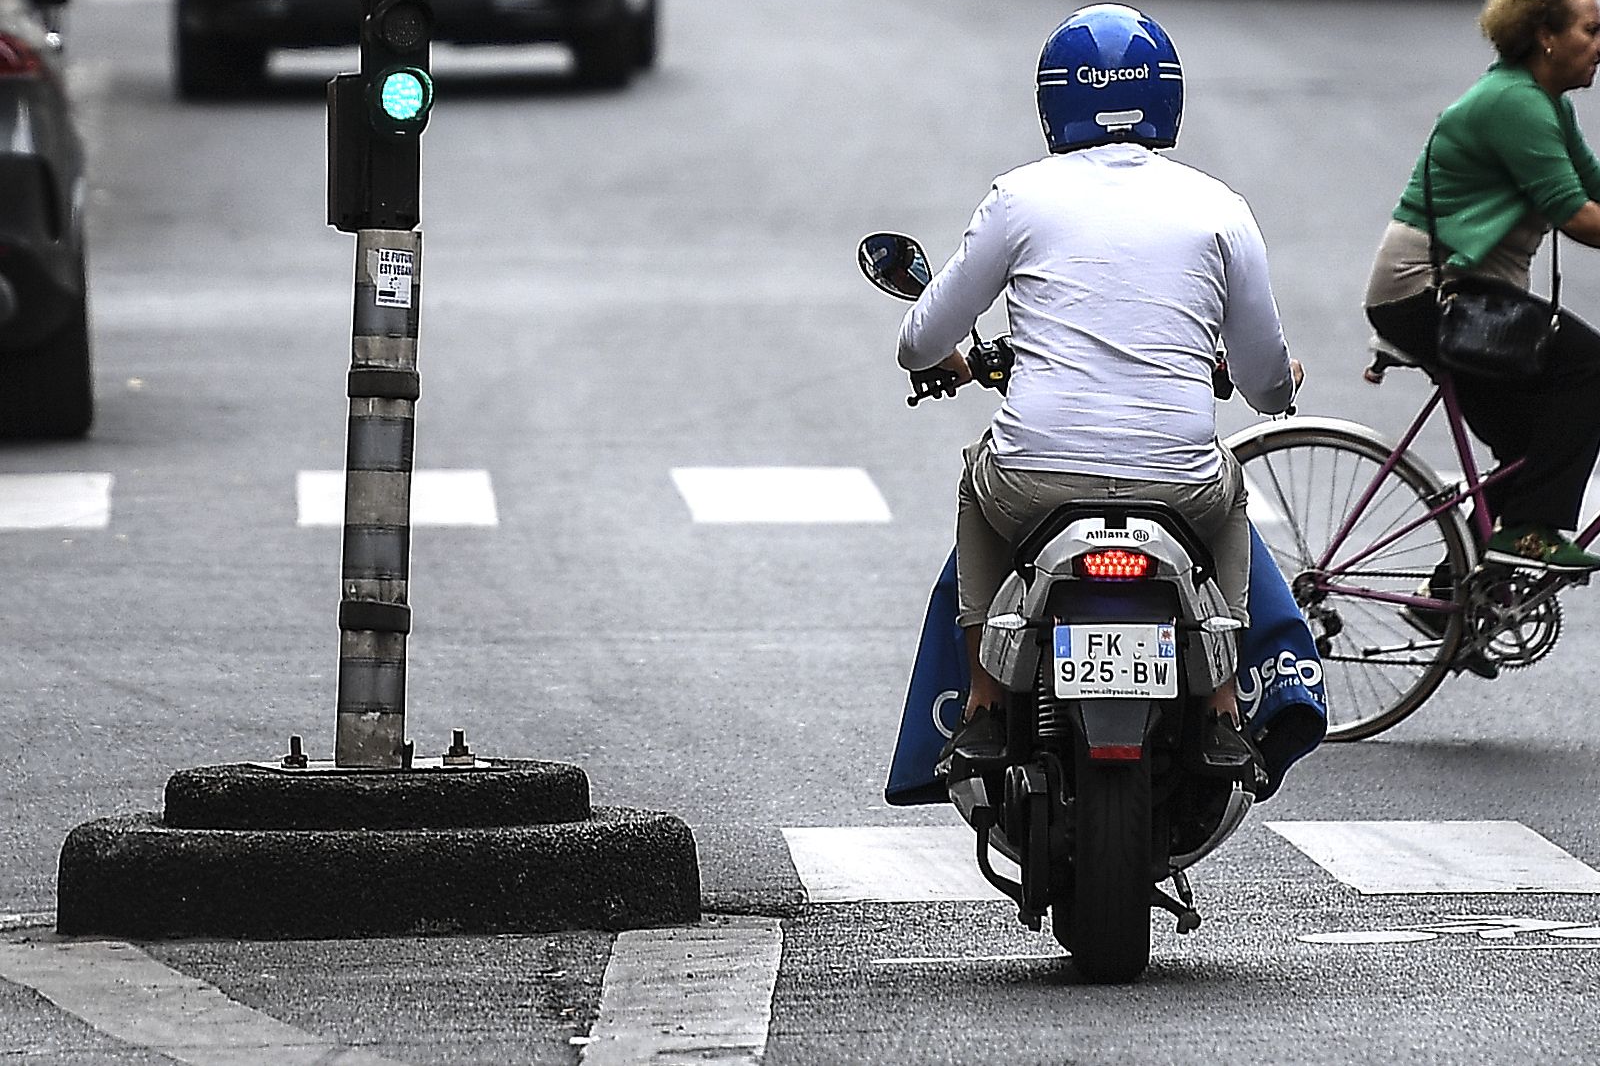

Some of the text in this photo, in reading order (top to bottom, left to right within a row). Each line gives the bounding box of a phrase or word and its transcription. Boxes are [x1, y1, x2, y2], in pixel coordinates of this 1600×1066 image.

[1076, 63, 1150, 88] Cityscoot
[380, 251, 390, 262] LE
[380, 264, 392, 275] EST
[1086, 530, 1130, 540] Allianz
[1160, 644, 1174, 656] 75
